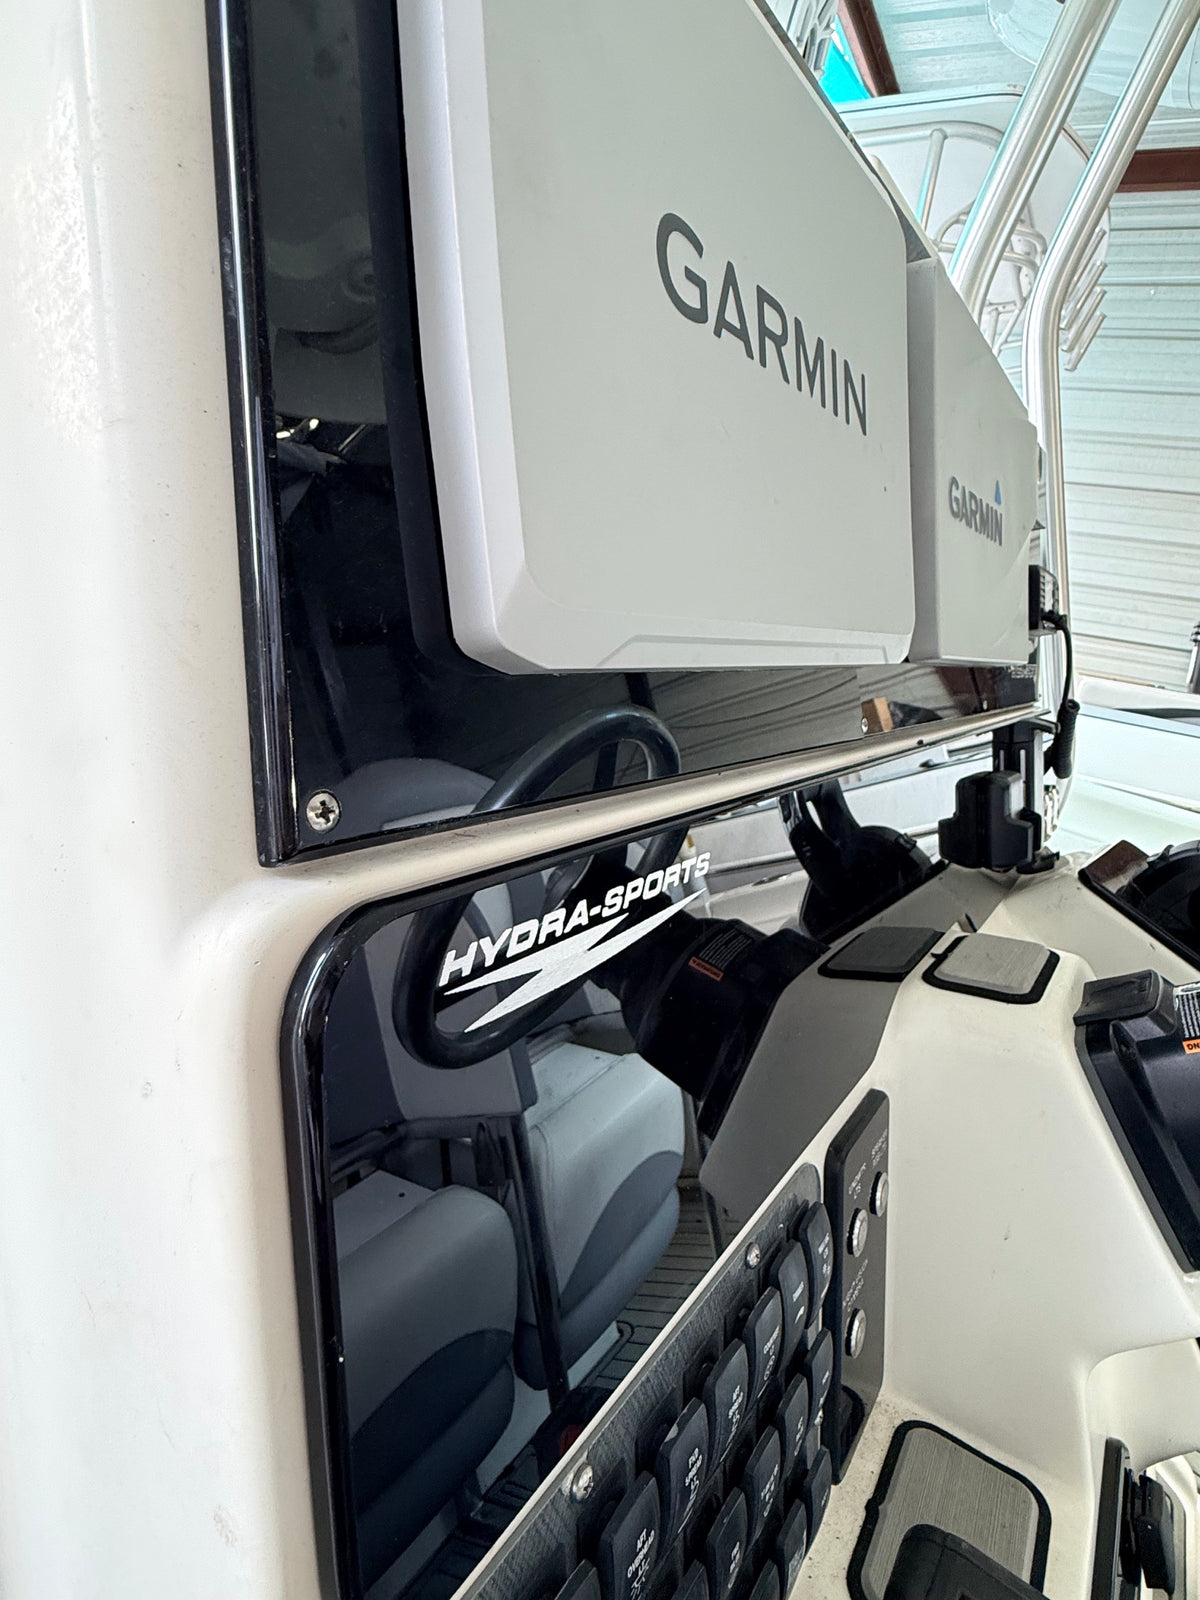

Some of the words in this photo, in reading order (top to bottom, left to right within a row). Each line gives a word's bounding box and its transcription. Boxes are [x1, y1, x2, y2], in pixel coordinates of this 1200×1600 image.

[655, 212, 868, 436] GARMIN
[948, 476, 1003, 547] GARMIN
[438, 851, 711, 987] HYDRA-SPORTS
[627, 1530, 655, 1579] OVERHEAD
[636, 1528, 647, 1553] AFT
